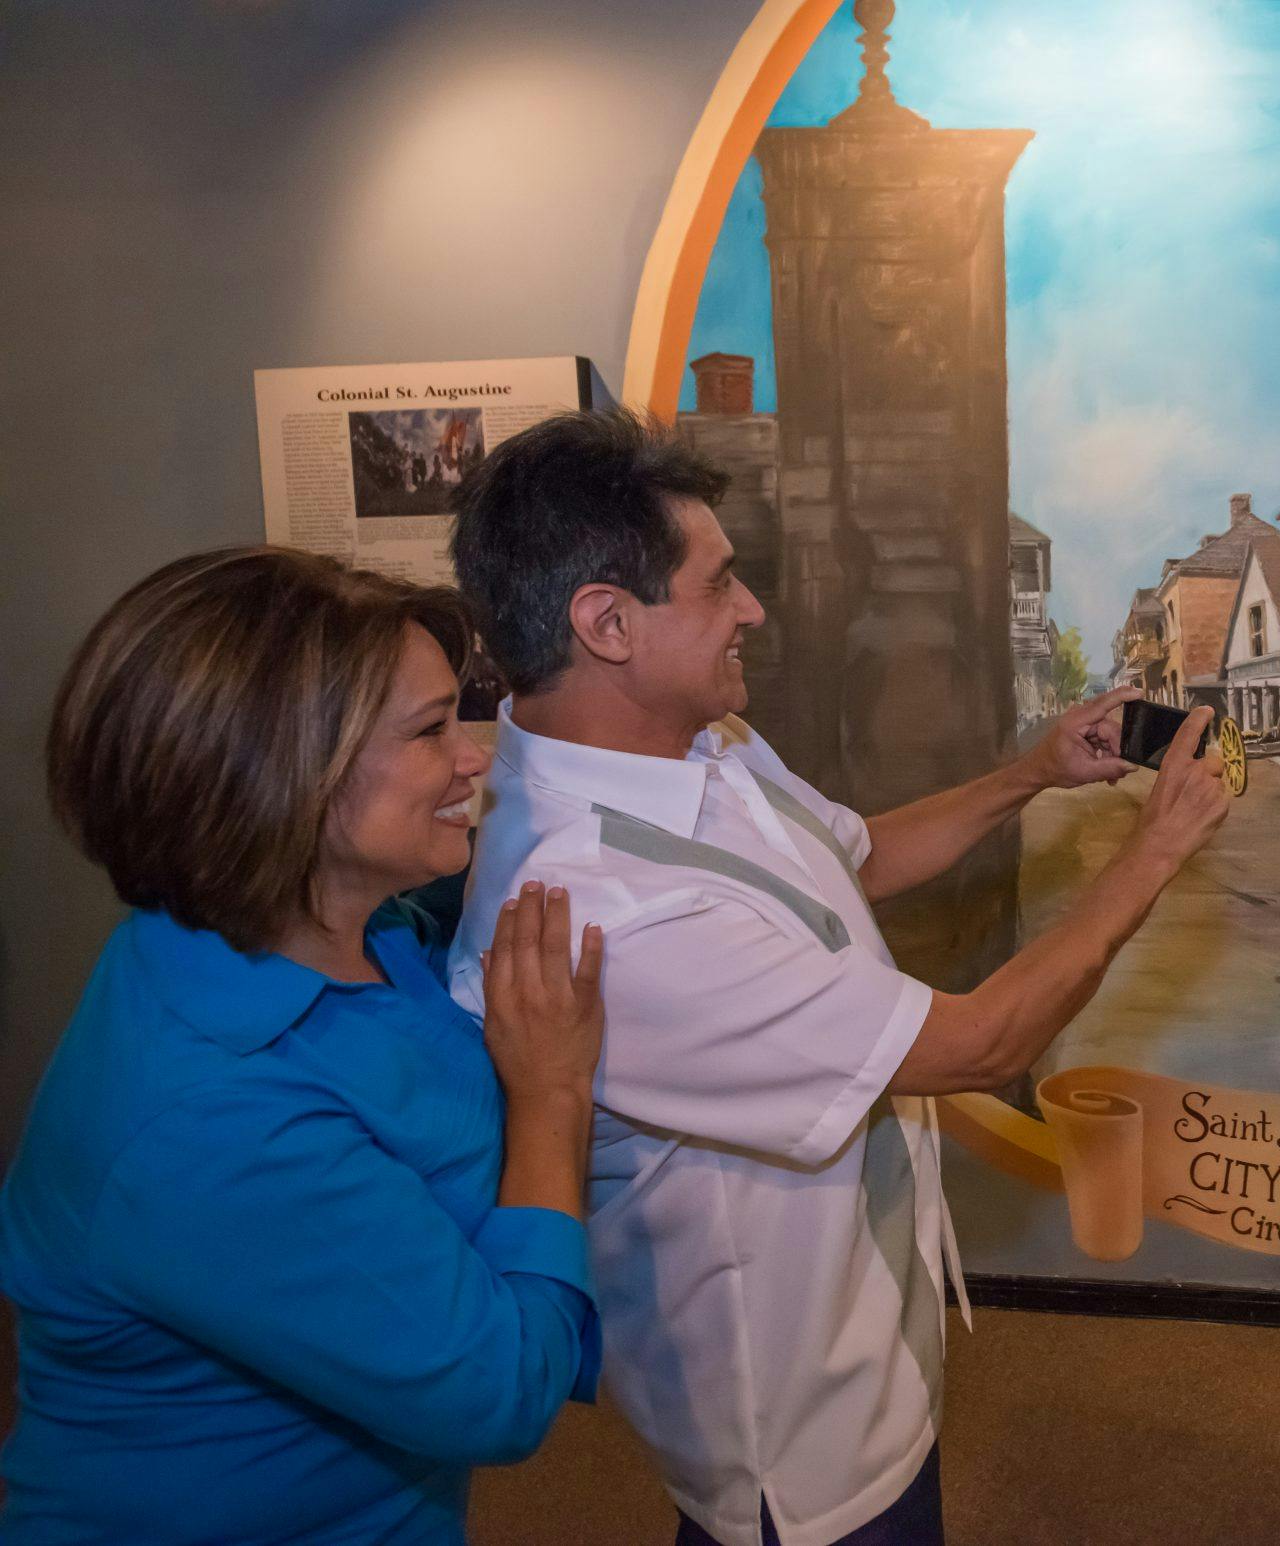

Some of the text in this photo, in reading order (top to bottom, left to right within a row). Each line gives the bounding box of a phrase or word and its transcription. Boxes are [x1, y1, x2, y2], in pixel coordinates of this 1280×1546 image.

[316, 382, 512, 402] Colonial St. Augustine
[1173, 1091, 1274, 1143] Saint
